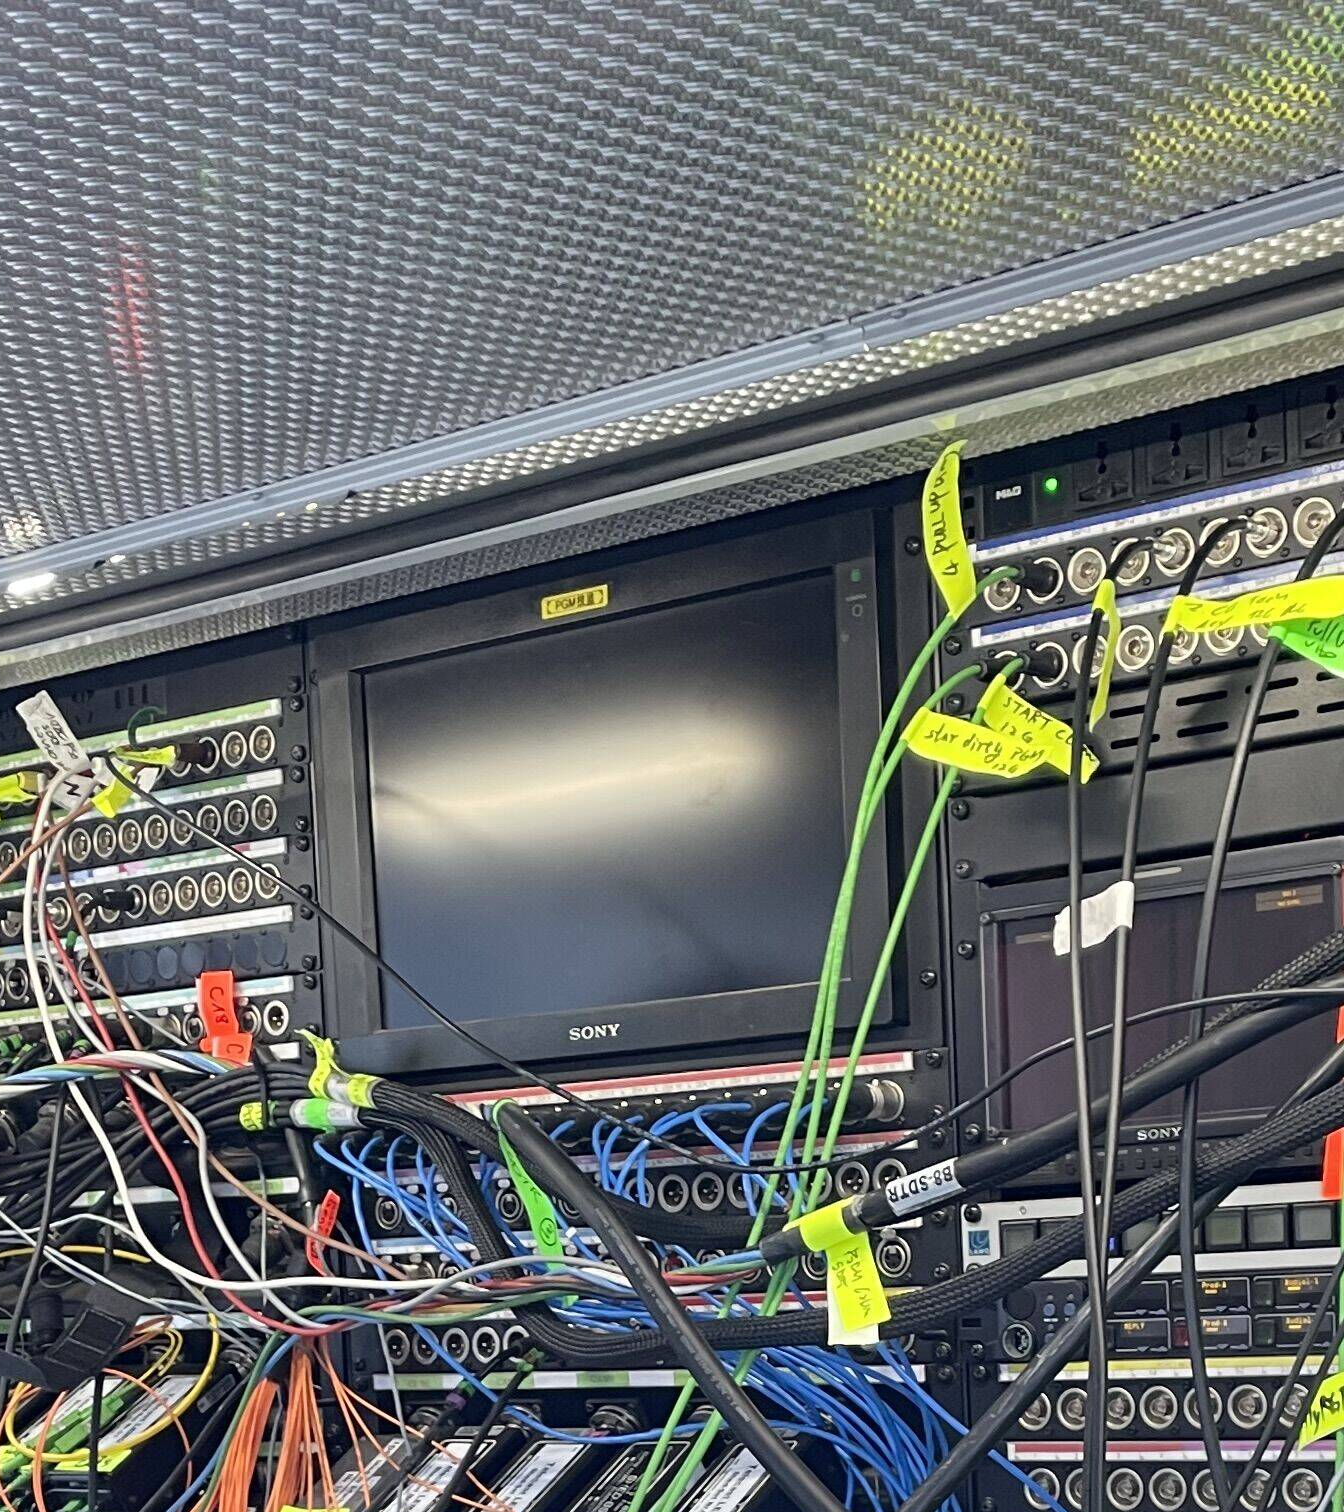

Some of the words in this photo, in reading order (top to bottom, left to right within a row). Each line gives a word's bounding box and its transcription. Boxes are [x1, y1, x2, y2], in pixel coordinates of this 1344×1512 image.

[569, 1023, 620, 1041] SONY
[1137, 1126, 1182, 1141] SONY
[887, 1165, 954, 1203] B8-SDTR
